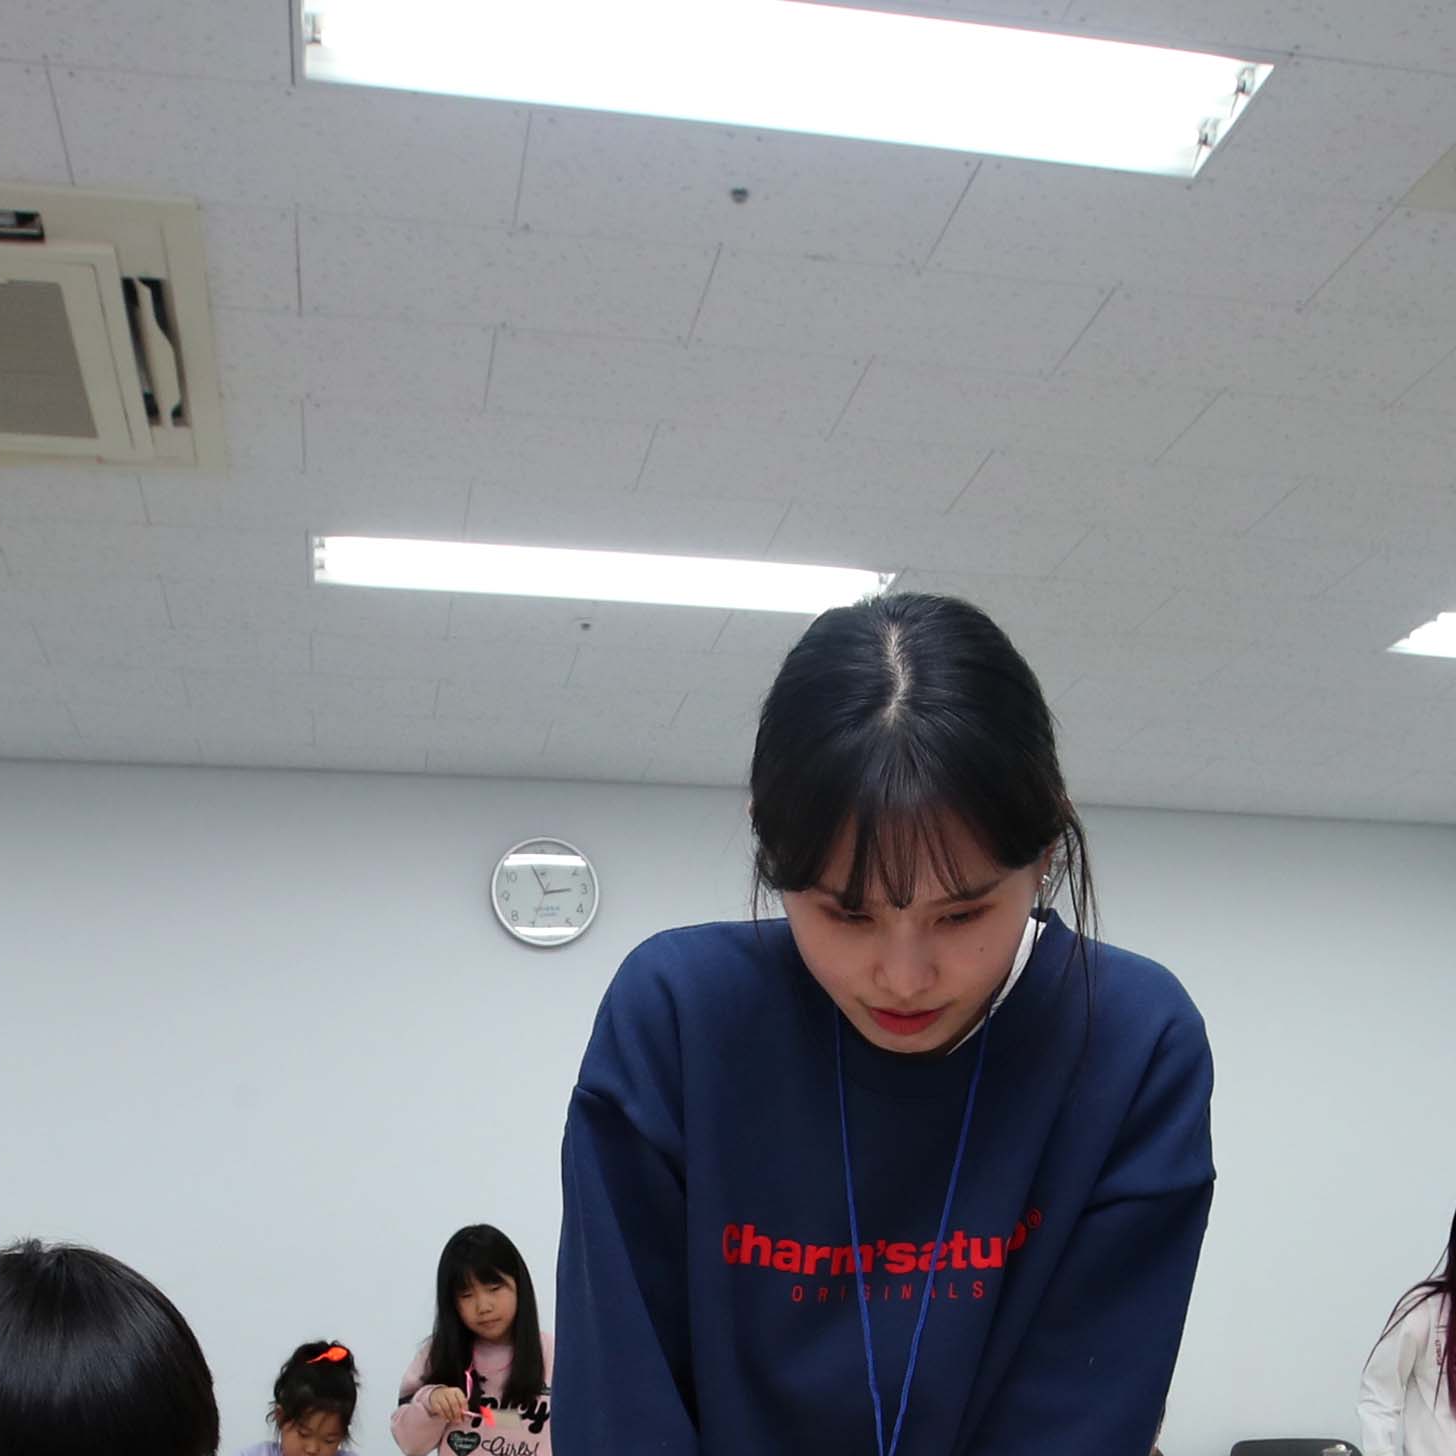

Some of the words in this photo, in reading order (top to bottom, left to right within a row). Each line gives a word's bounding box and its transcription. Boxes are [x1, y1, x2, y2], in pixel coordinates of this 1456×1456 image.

[505, 871, 518, 884] 10
[580, 883, 588, 895] 3
[502, 891, 510, 901] 9
[576, 903, 584, 913] 4
[511, 911, 519, 922] 8
